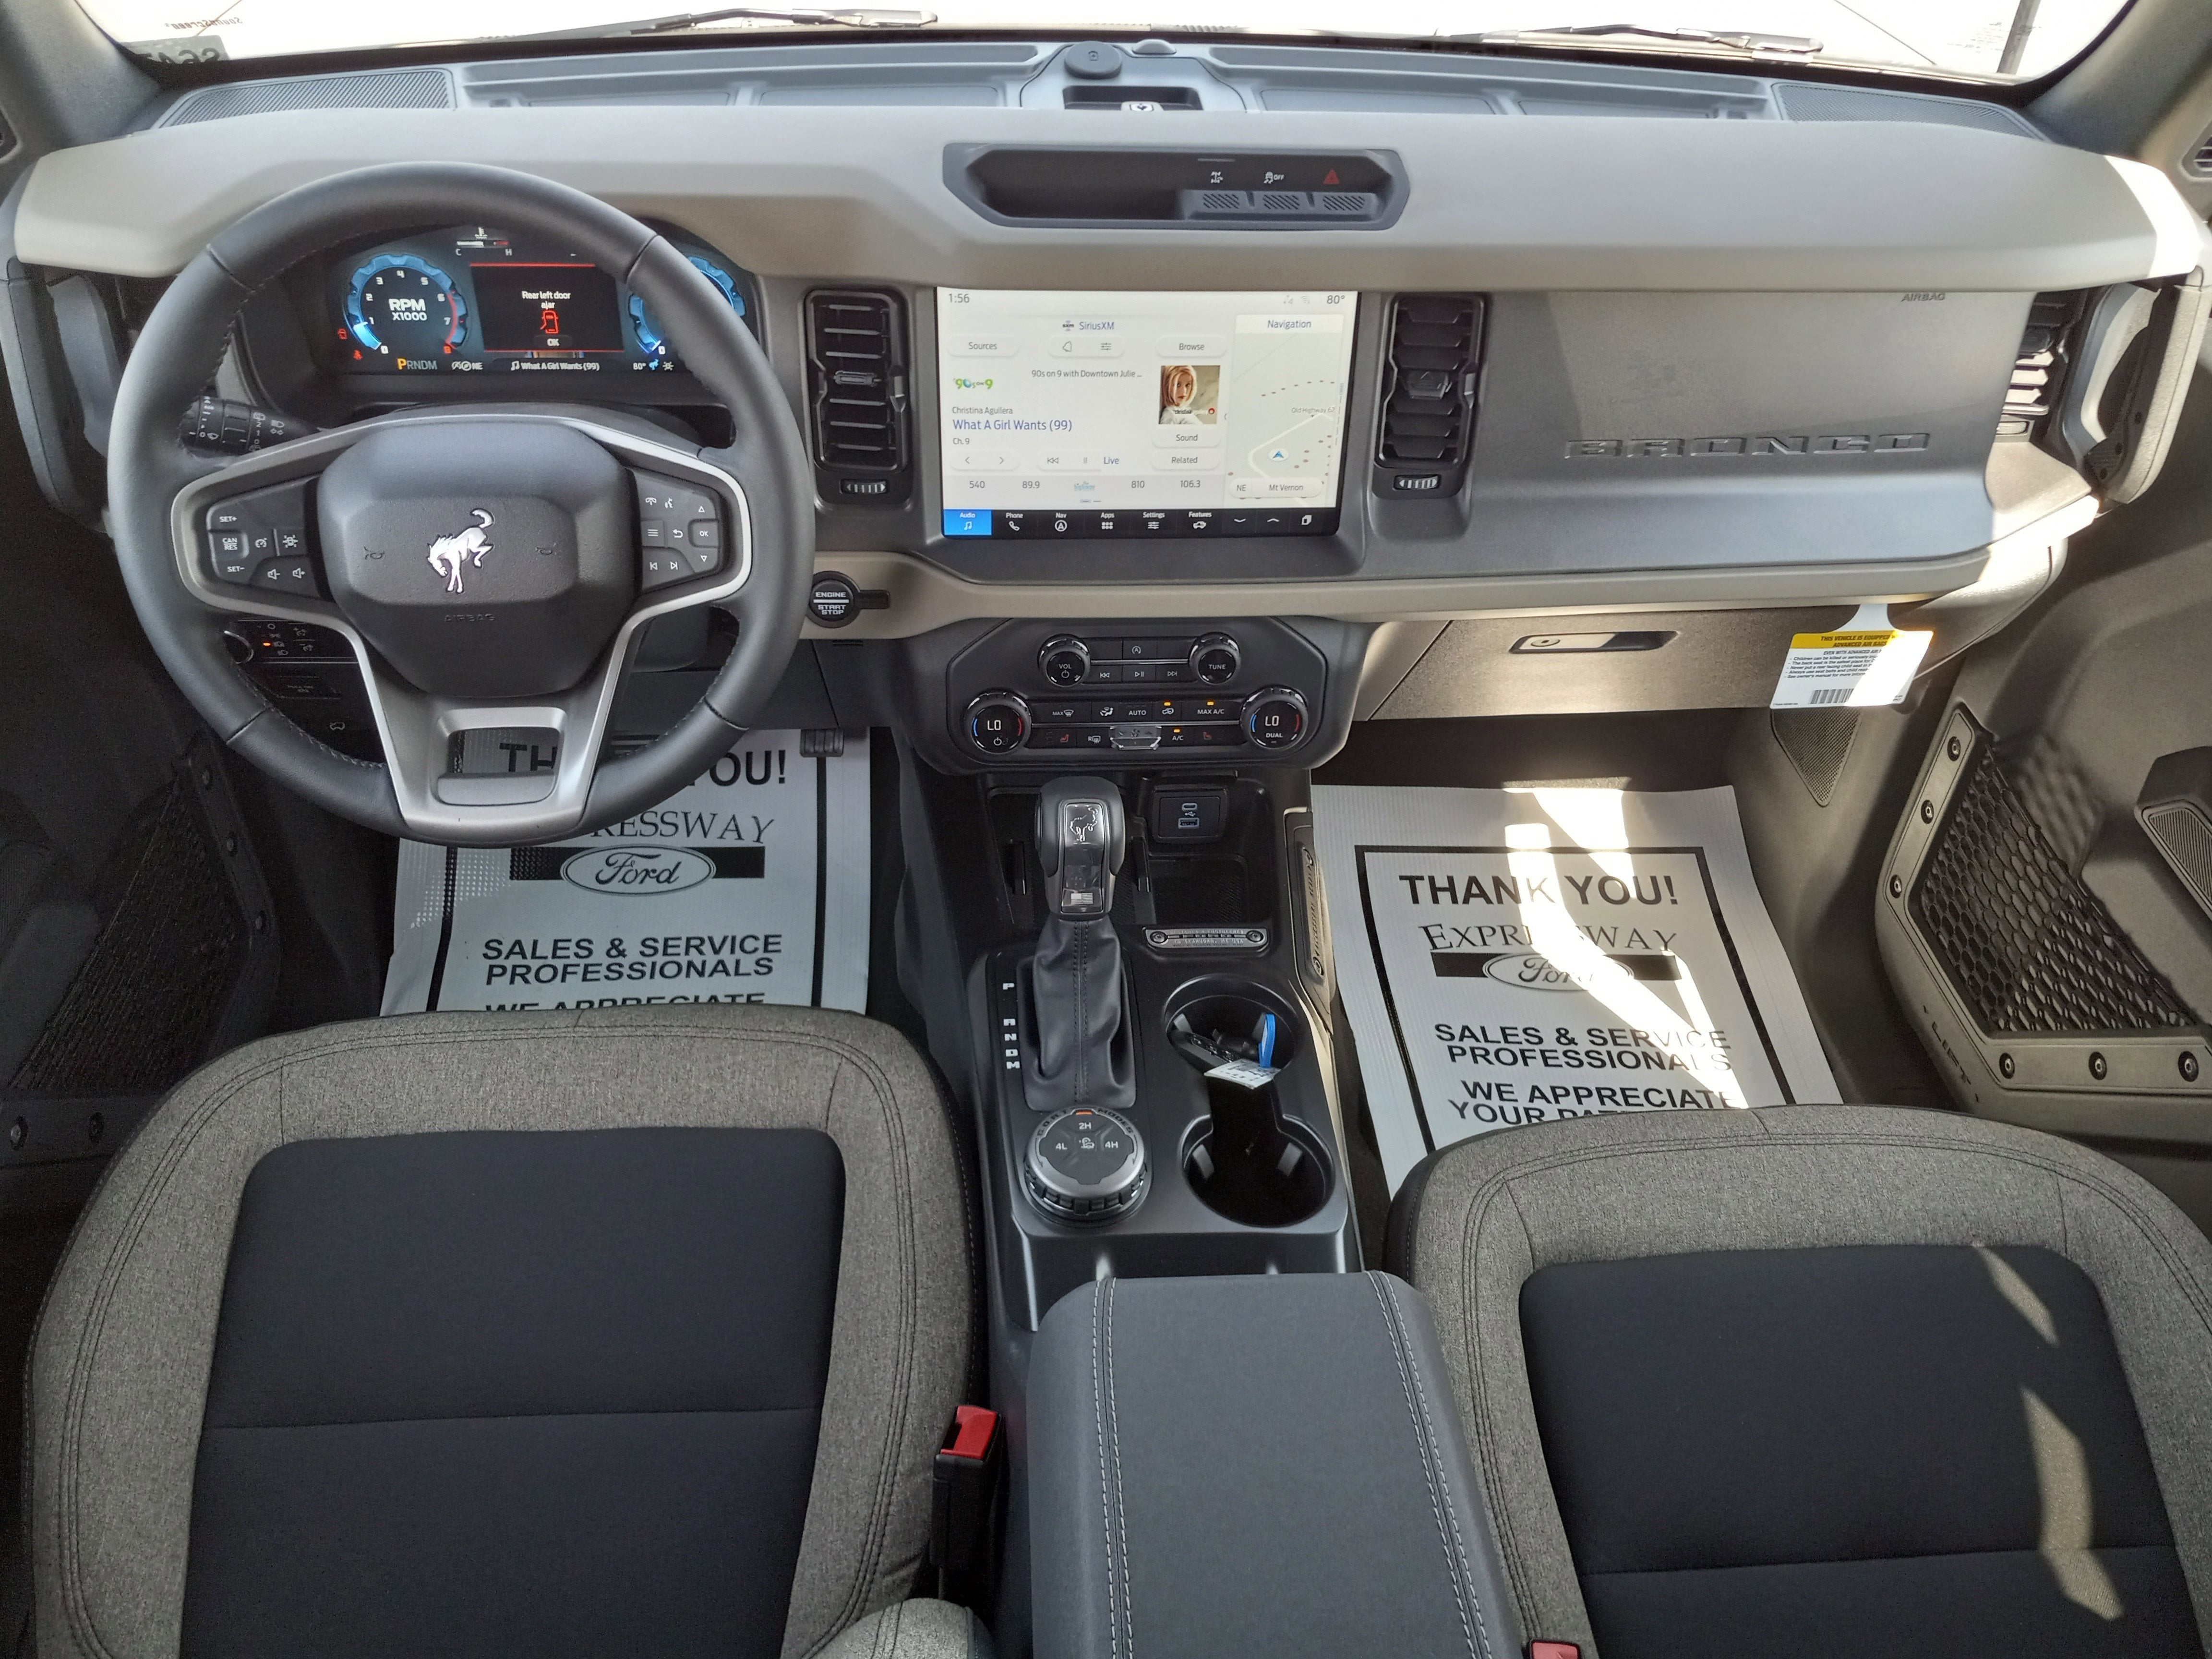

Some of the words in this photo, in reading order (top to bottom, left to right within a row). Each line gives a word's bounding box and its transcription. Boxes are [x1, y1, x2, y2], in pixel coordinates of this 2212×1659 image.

[437, 293, 445, 301] 6
[949, 293, 970, 303] 1:56
[1327, 295, 1345, 304] 80°
[1901, 292, 1946, 301] AIRBAG
[388, 299, 425, 311] RPM
[541, 301, 555, 310] ajar
[392, 313, 427, 321] X1000
[1079, 322, 1114, 330] SiriusXM
[1267, 320, 1311, 329] Navigation
[381, 345, 388, 354] 0
[444, 345, 452, 354] 8
[968, 342, 998, 350] Sources
[472, 362, 483, 370] NE
[583, 362, 600, 371] (99)
[984, 407, 1013, 415] Aguilera
[953, 420, 982, 430] What
[984, 420, 991, 430] A
[994, 420, 1011, 430] Girl
[1013, 420, 1046, 430] Wants
[1049, 420, 1072, 431] (99)
[1565, 433, 1930, 459] BRONCO
[445, 614, 495, 622] AIRBAG
[987, 720, 1001, 731] LO
[1265, 716, 1279, 726] LO
[691, 749, 786, 786] OU!
[595, 852, 682, 885] Ford
[1399, 875, 1556, 904] THANK
[1564, 875, 1678, 905] YOU!
[1418, 924, 1677, 952] EXPRWAY
[483, 938, 594, 961] SALES
[606, 939, 626, 958] &
[639, 934, 782, 956] SERVICE
[486, 958, 774, 986] PROFESSIONALS
[1518, 958, 1593, 983] For
[1434, 1024, 1543, 1045] SALES
[1555, 1027, 1578, 1046] &
[1586, 1028, 1731, 1048] SERVICE
[1447, 1045, 1732, 1071] PROFESSIONALS
[1461, 1080, 1518, 1102] WE
[1528, 1085, 1744, 1109] APPRECIATE
[1448, 1100, 1547, 1124] YOUR
[1098, 1108, 1133, 1133] MODES
